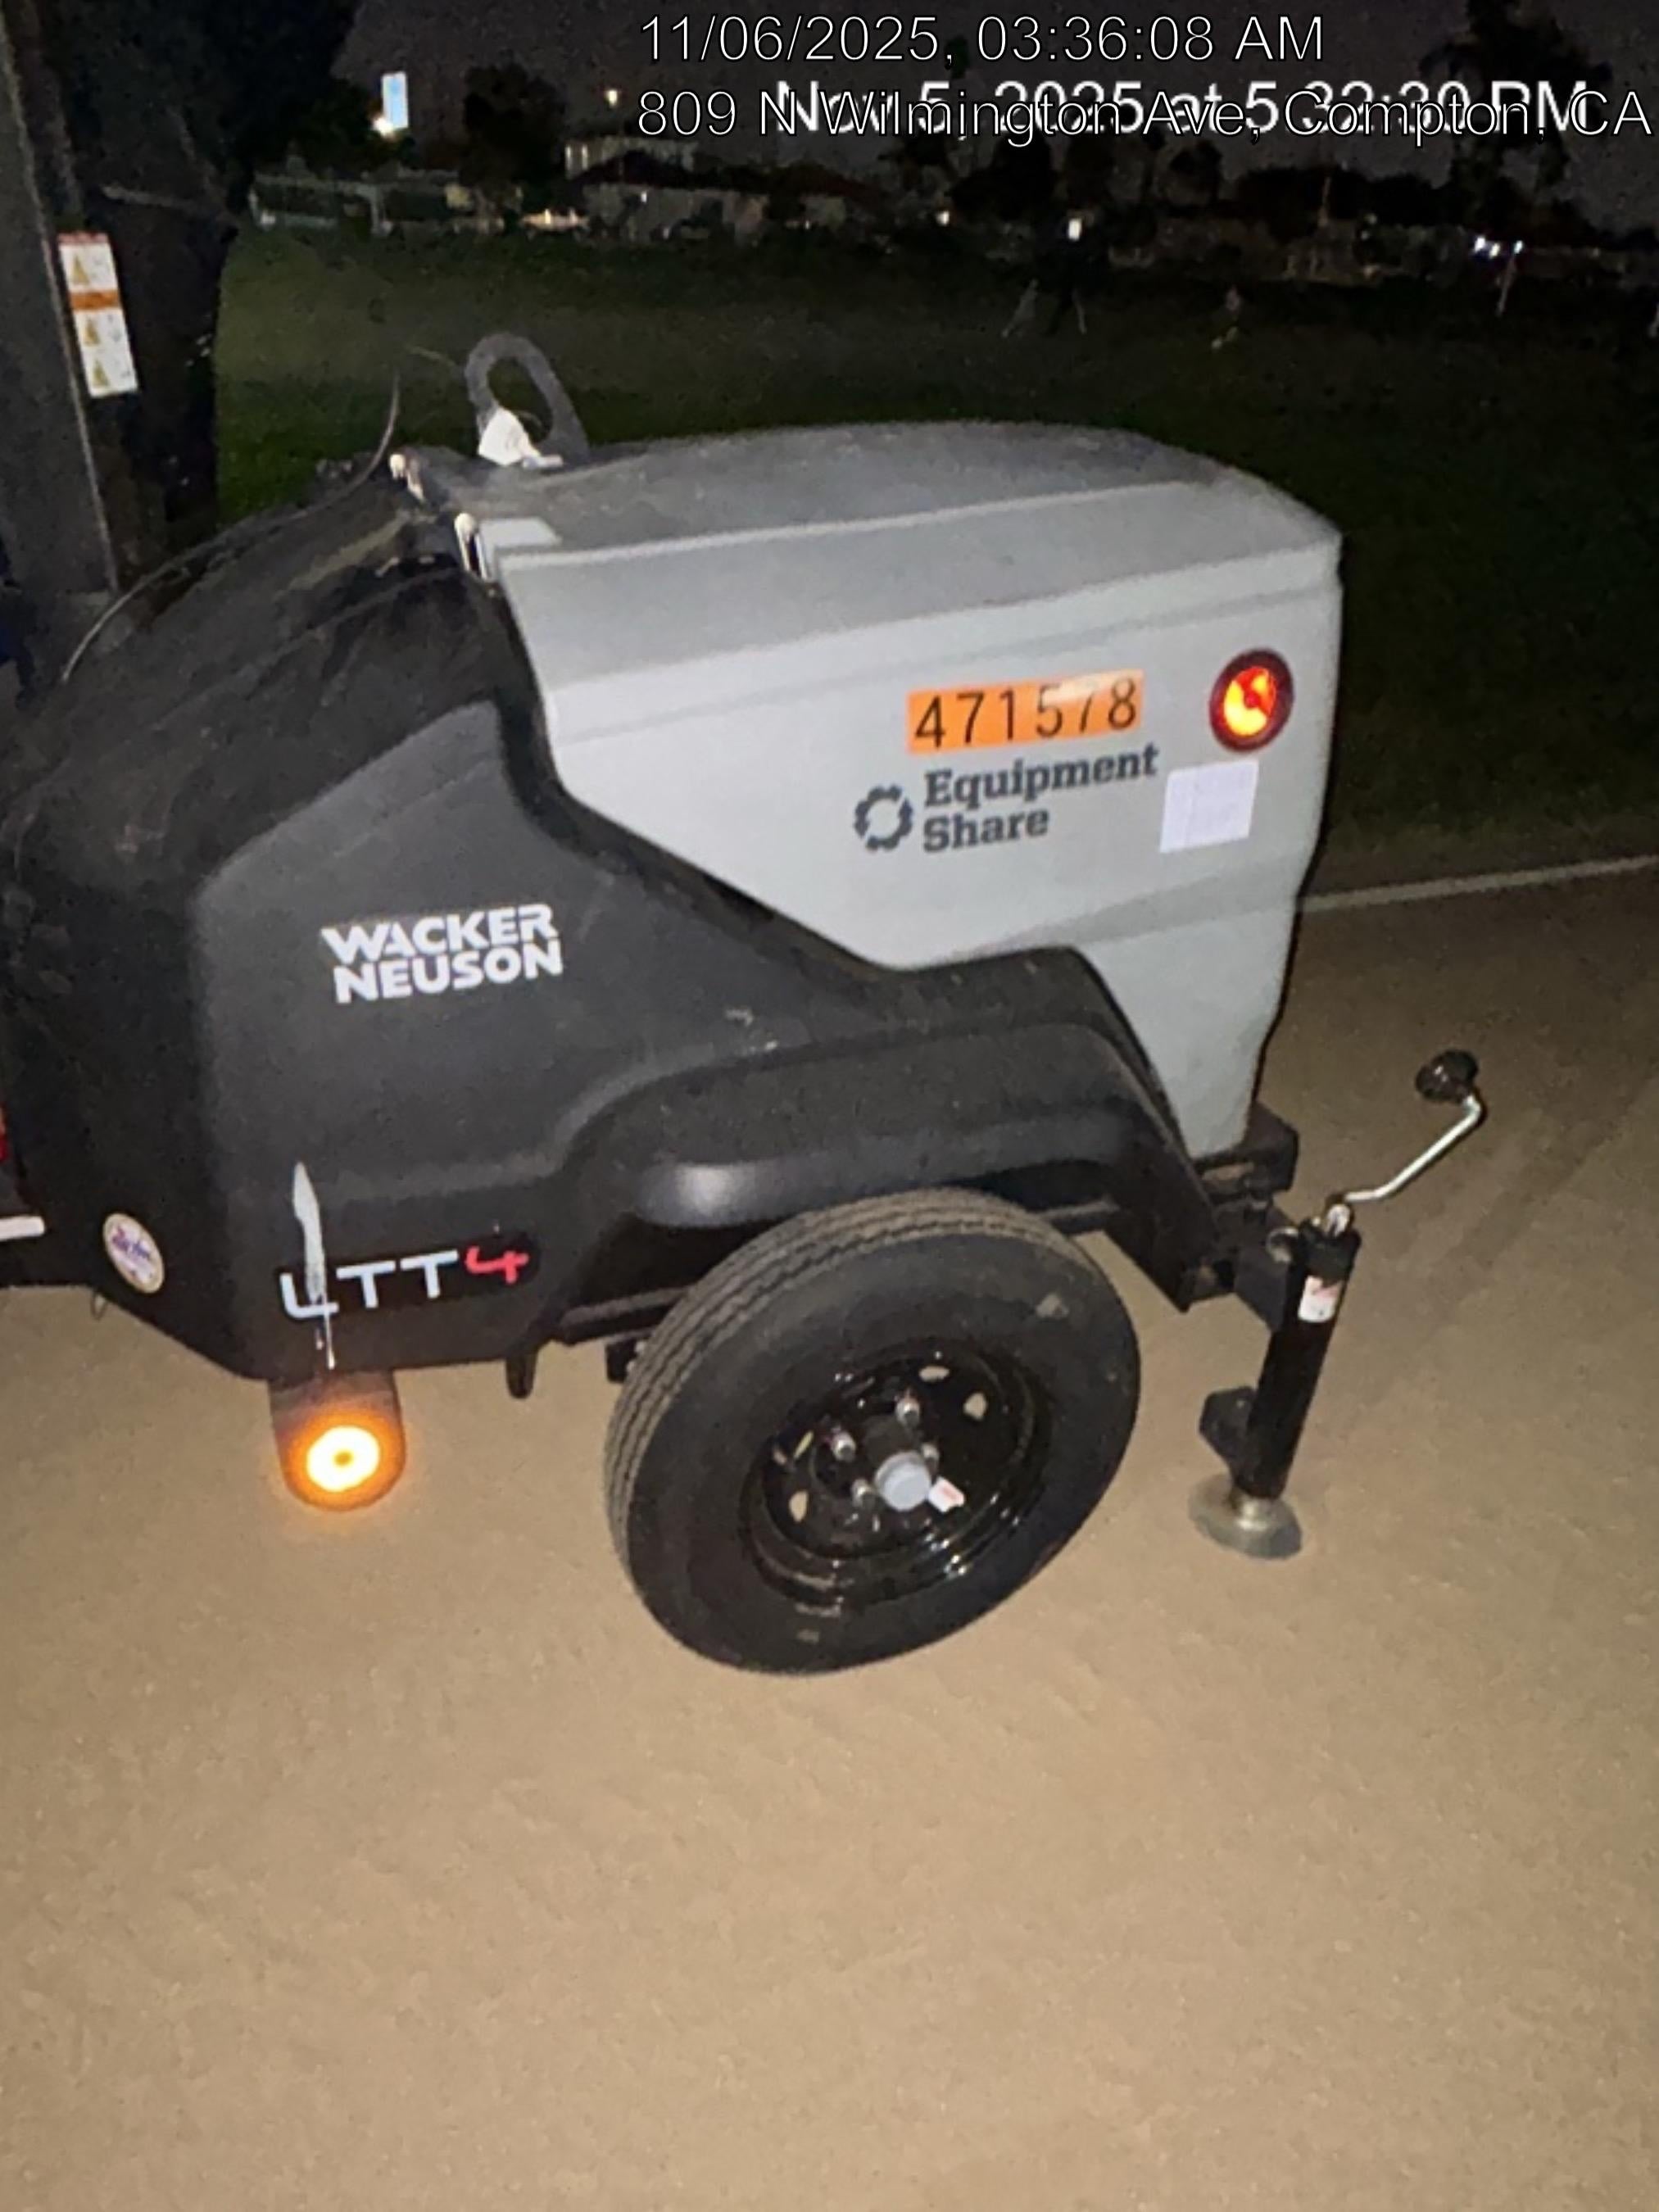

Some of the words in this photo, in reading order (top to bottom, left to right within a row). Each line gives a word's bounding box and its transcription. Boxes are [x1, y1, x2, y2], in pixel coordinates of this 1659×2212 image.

[913, 678, 1137, 749] 471578
[923, 742, 1160, 811] Equipment
[923, 807, 1050, 854] Share
[320, 903, 559, 966] WACKER
[333, 938, 564, 1004] NEUSON
[279, 1245, 530, 1320] LTT4
